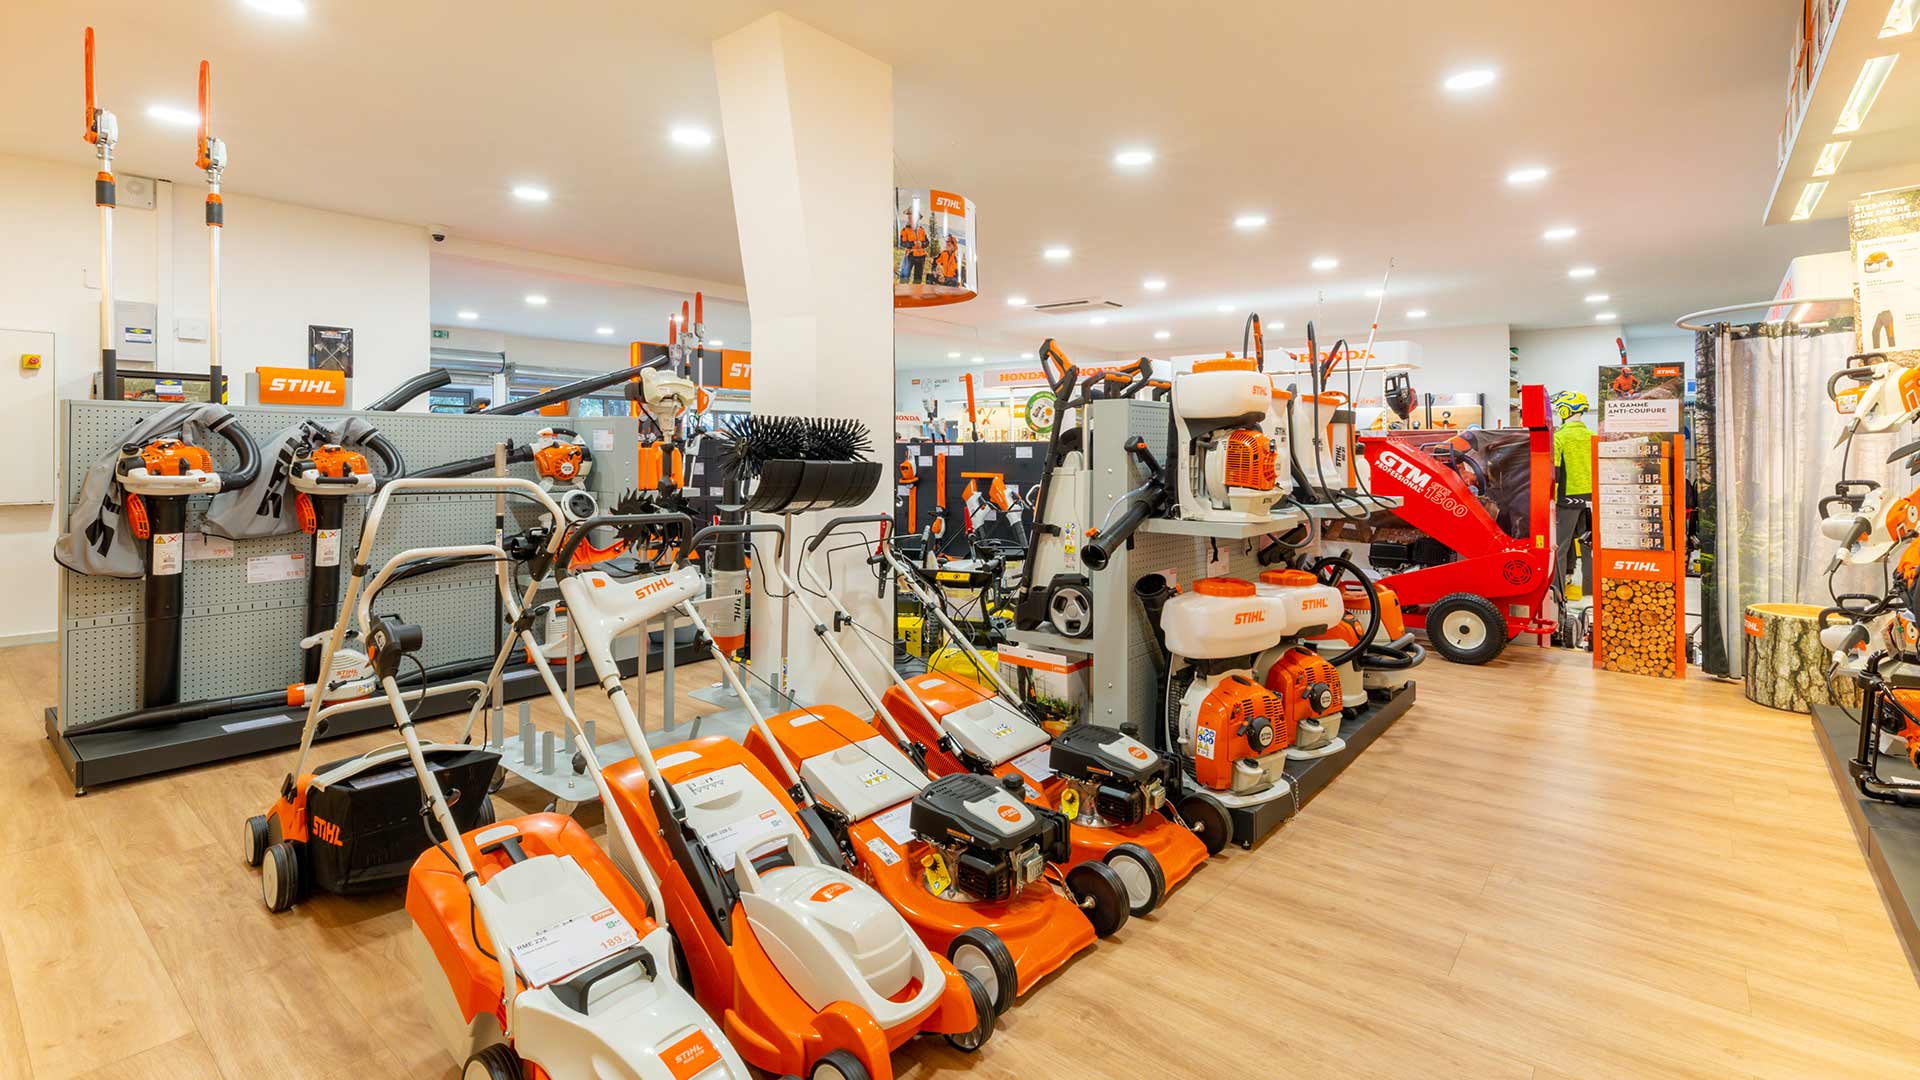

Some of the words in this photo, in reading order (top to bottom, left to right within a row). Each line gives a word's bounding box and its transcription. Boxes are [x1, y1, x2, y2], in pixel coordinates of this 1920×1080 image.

[936, 197, 960, 209] STIHL
[269, 378, 337, 394] STIHL
[999, 371, 1048, 382] HONDA
[1374, 459, 1423, 493] PROFESSIONAL
[1380, 451, 1432, 488] GTM
[1424, 486, 1468, 518] 1300
[1613, 560, 1660, 572] STIHL
[634, 577, 674, 600] STIHL
[734, 588, 742, 622] STIHL
[1301, 598, 1329, 611] STIHL
[1234, 610, 1265, 624] STIHL
[313, 816, 343, 846] STIHL
[675, 1044, 704, 1064] STIHL
